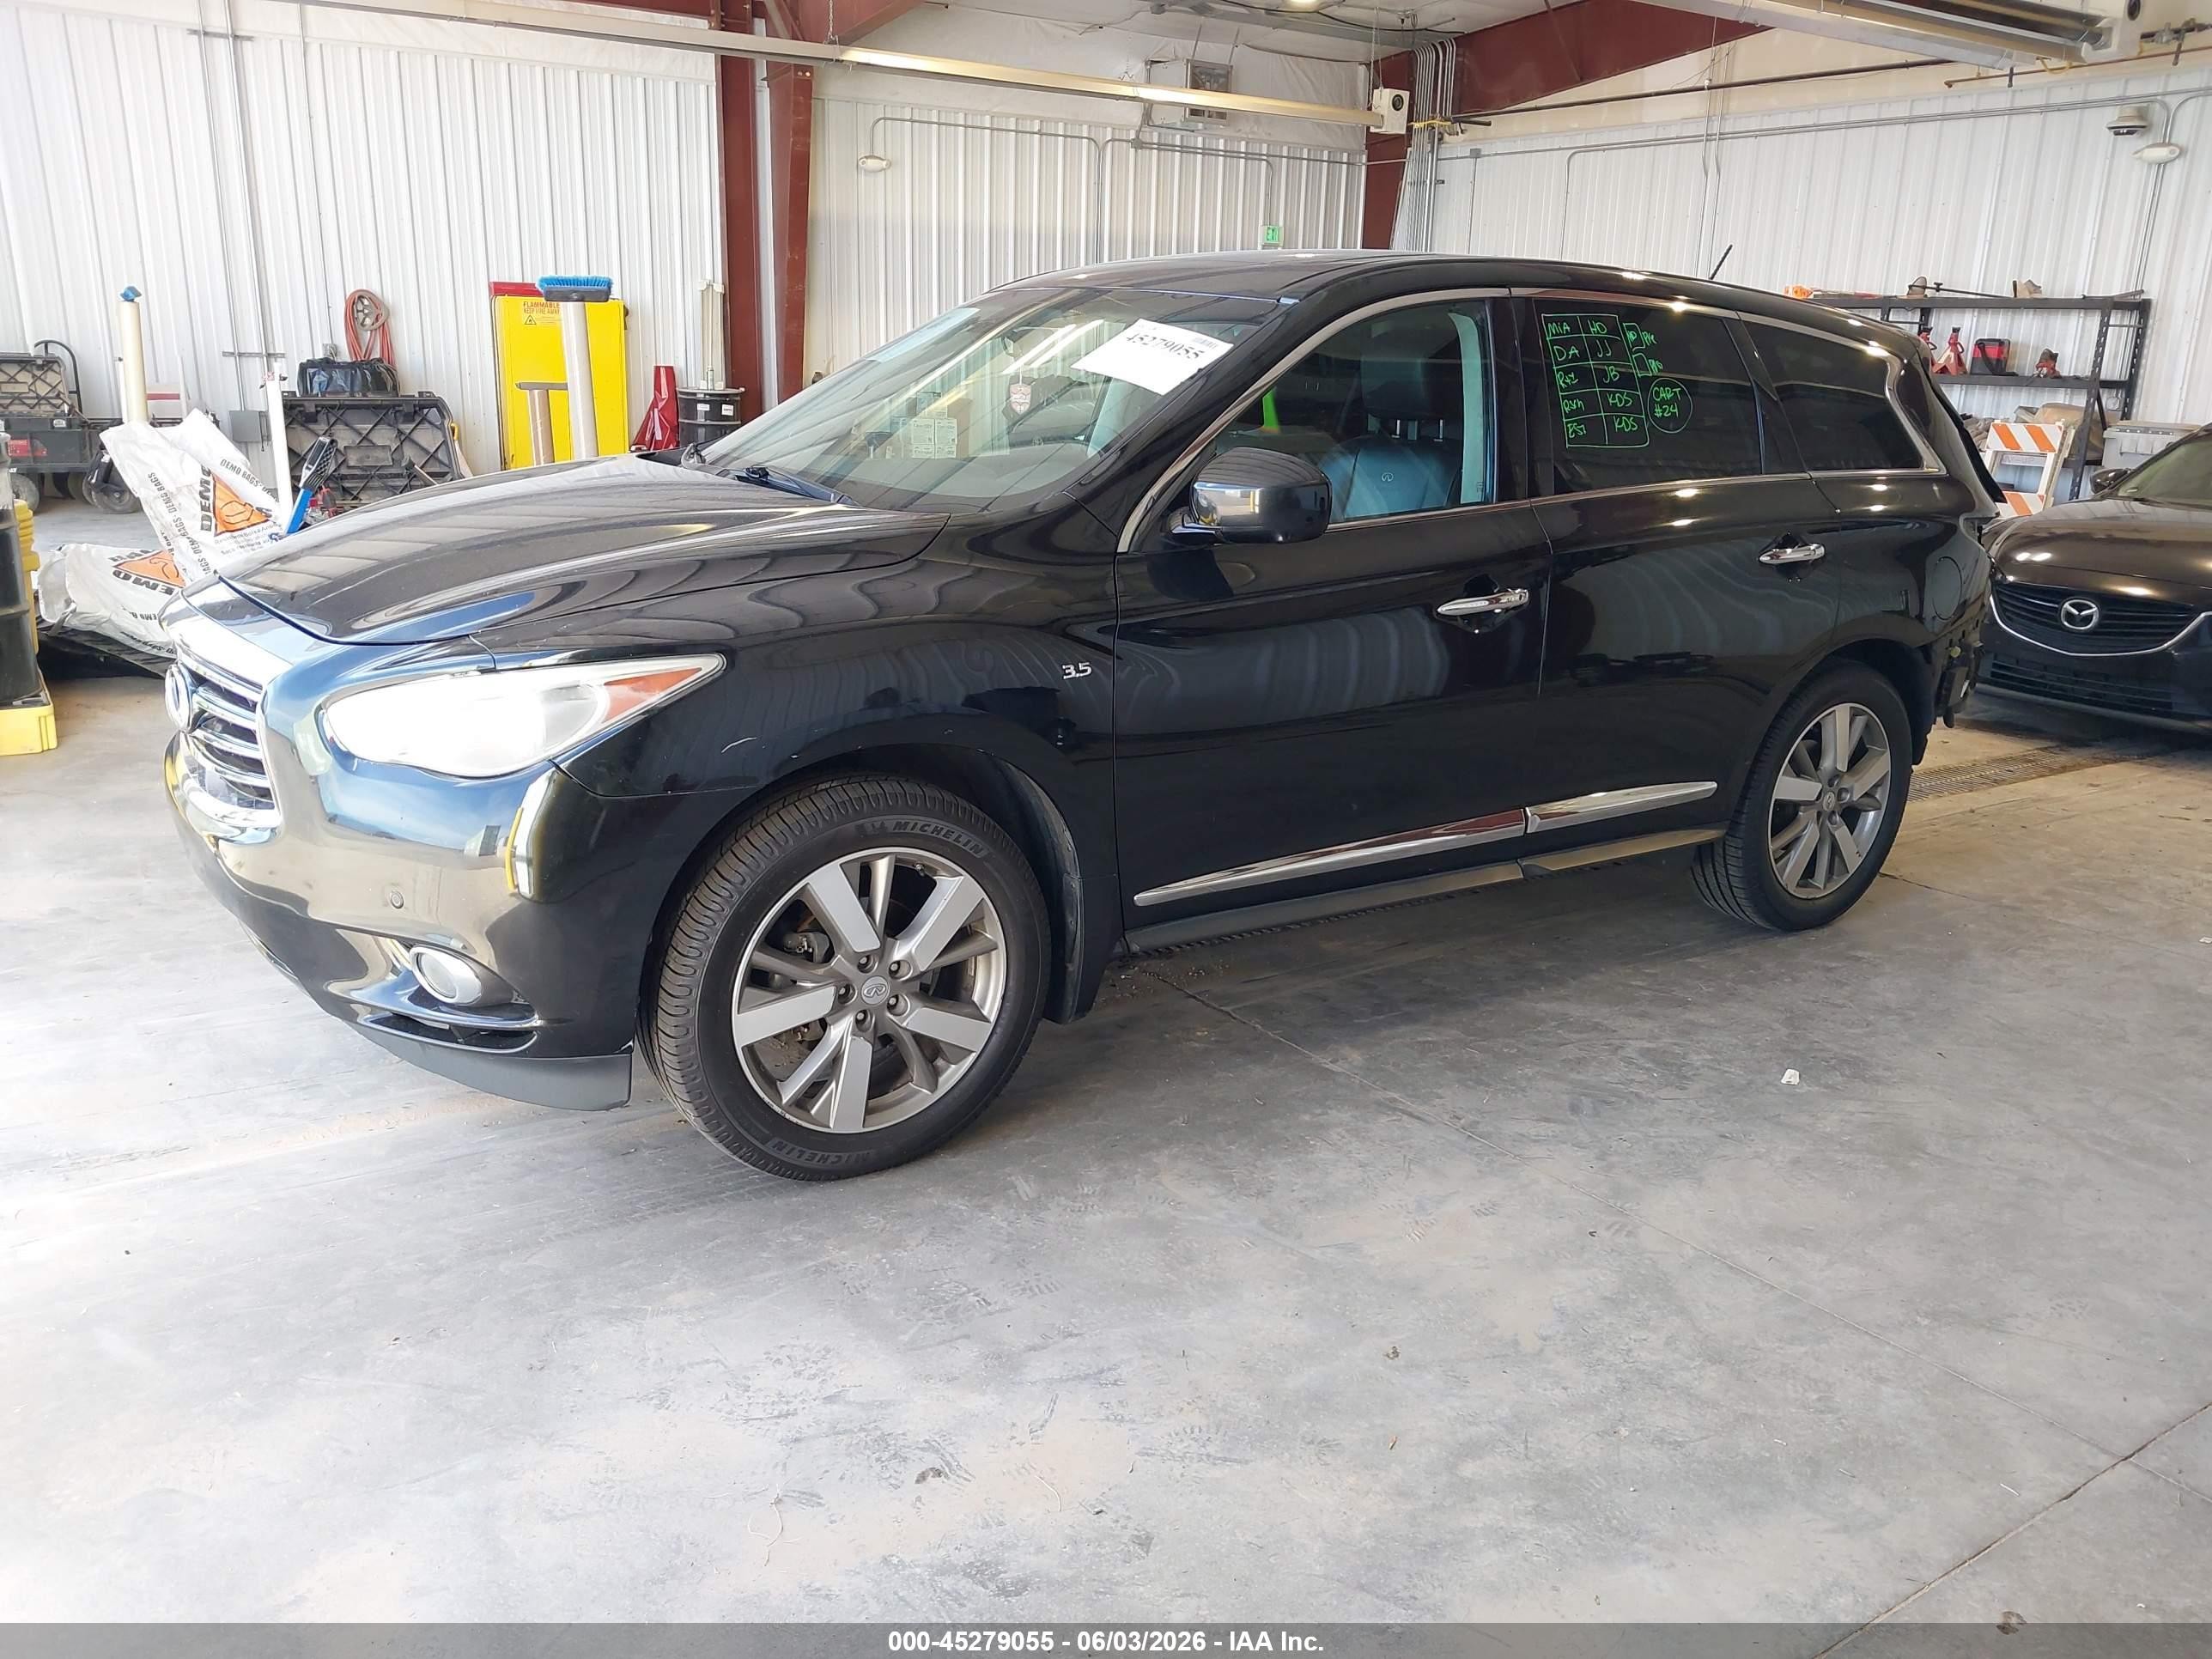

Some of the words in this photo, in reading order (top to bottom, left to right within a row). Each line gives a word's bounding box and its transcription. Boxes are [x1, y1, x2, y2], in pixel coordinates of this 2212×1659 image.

[1126, 332, 1206, 360] 45279055
[1553, 345, 1580, 362] DA
[1596, 339, 1613, 358] JJ
[1602, 366, 1620, 384] JB
[1607, 392, 1633, 408] KDS
[1652, 386, 1683, 402] CART
[1654, 403, 1680, 418] #24
[1613, 416, 1639, 433] KDS
[148, 471, 166, 493] BAGS
[220, 459, 242, 476] DEMO
[242, 471, 260, 488] BAGS
[112, 569, 176, 596] EMO
[892, 821, 985, 856] MICHELIN
[772, 1140, 872, 1165] MICHELIN
